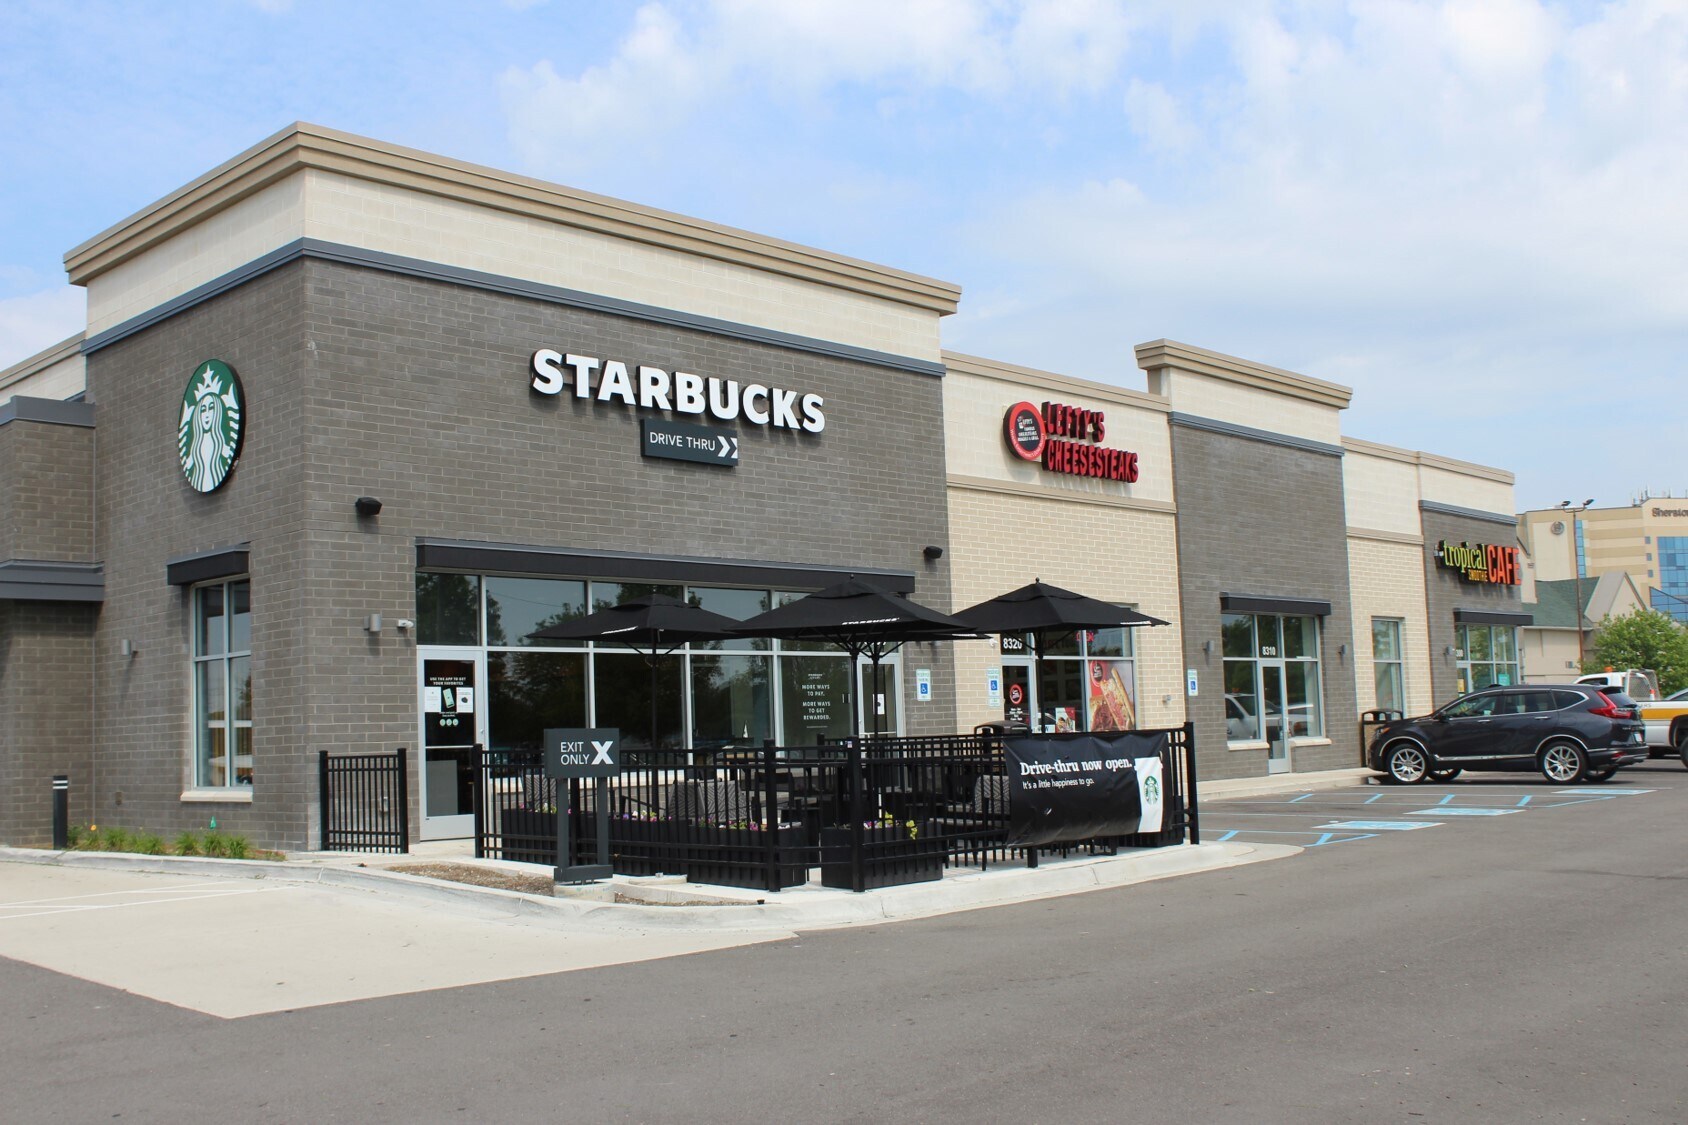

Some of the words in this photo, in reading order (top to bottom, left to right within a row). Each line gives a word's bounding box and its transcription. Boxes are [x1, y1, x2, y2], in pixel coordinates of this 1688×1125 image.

[530, 348, 826, 434] STARBUCKS
[1042, 401, 1106, 442] LEFTY'S
[649, 431, 683, 447] DRIVE
[685, 436, 716, 452] THRU
[1043, 438, 1139, 483] CHEESESTEAKS
[1443, 540, 1487, 573] tropical
[1487, 544, 1522, 585] CAFE
[560, 741, 584, 753] EXIT
[560, 753, 590, 766] ONLY
[1020, 759, 1080, 776] Drive-thru
[1081, 760, 1103, 772] now
[1105, 758, 1133, 772] open.
[1022, 781, 1032, 790] It's
[1038, 780, 1051, 789] little
[1051, 778, 1079, 789] happiness
[1085, 778, 1095, 787] go.
